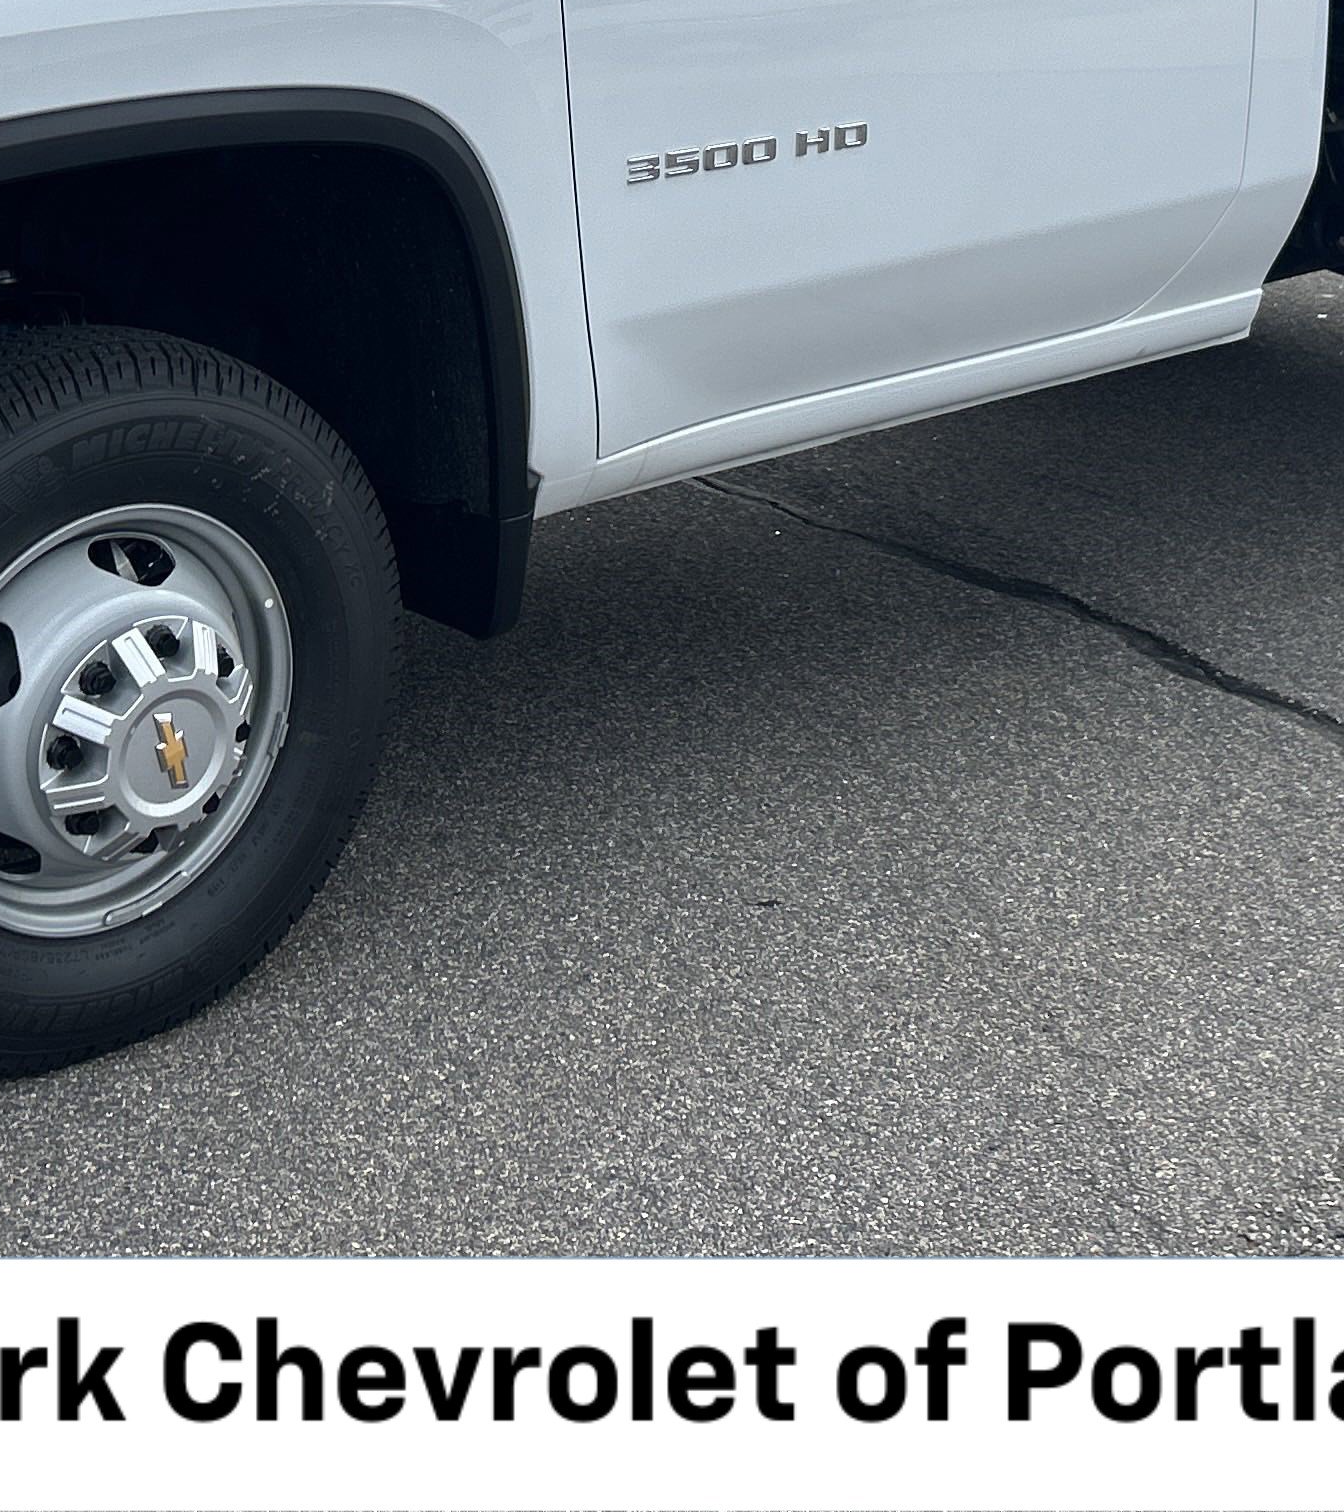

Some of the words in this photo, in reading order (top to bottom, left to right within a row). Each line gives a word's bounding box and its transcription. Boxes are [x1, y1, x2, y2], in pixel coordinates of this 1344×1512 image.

[626, 135, 777, 186] 3500
[795, 121, 868, 157] HD
[70, 417, 268, 472] MICHELIN
